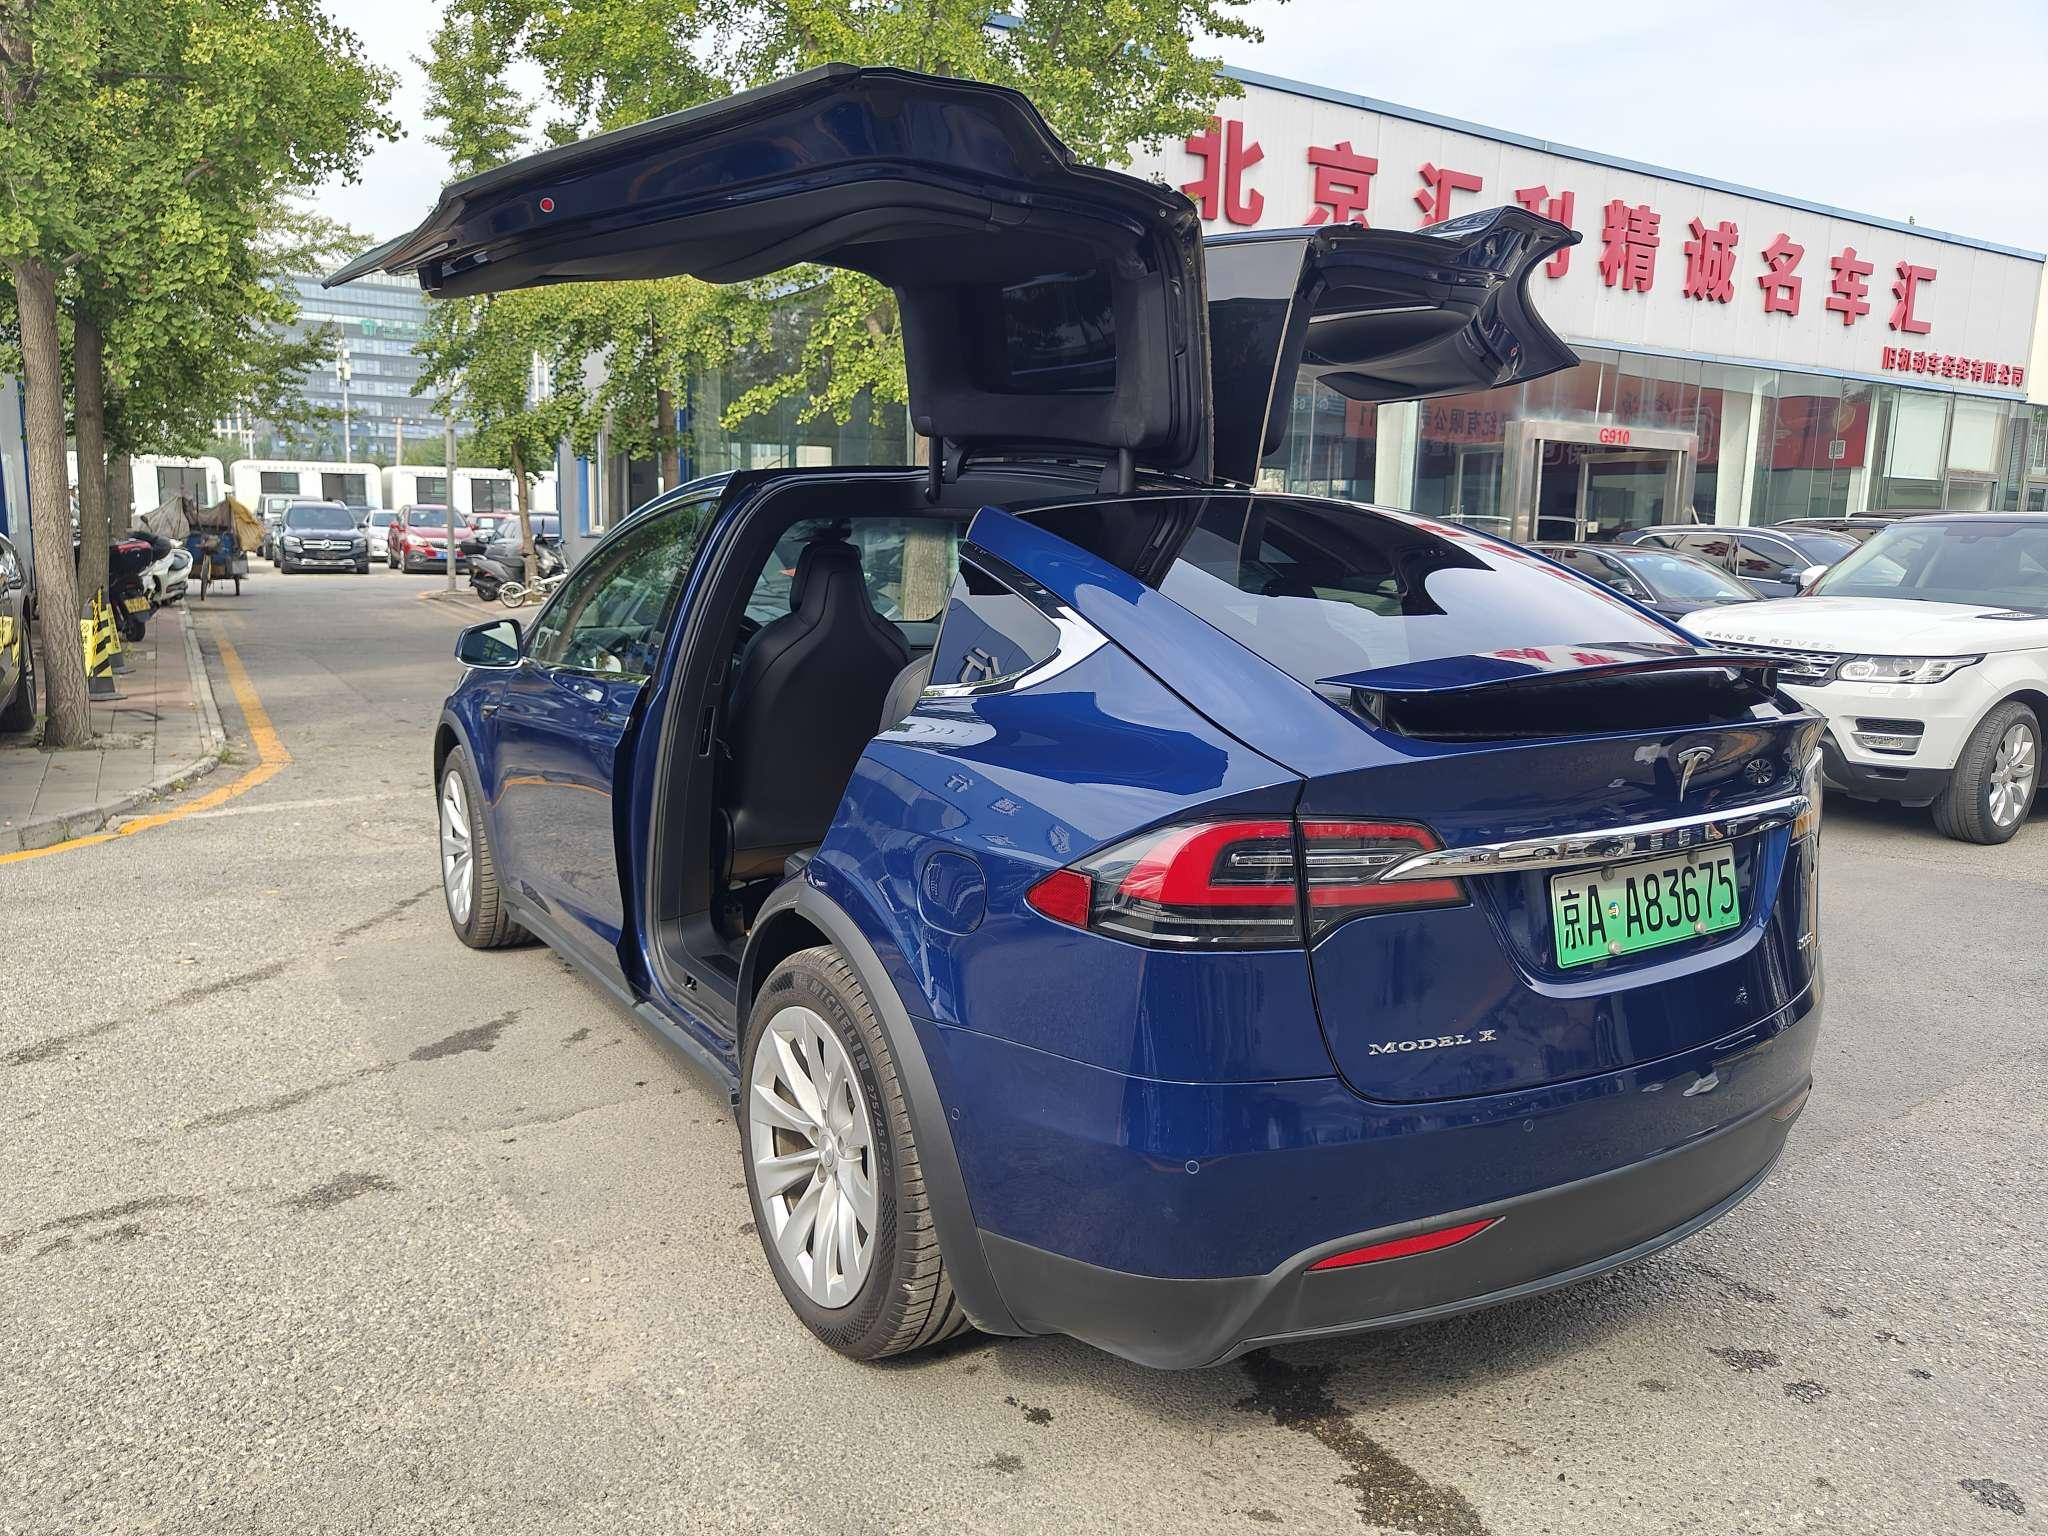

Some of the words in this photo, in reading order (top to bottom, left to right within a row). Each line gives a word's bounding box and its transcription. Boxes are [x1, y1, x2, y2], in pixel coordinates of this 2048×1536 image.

[1881, 346, 2024, 387] 旧机动车经纪有限公司
[1600, 428, 1630, 444] G910
[1704, 630, 1757, 642] RANGE
[808, 977, 871, 1071] MICHELIN
[1368, 1034, 1472, 1056] MODEL
[1479, 1029, 1497, 1042] X
